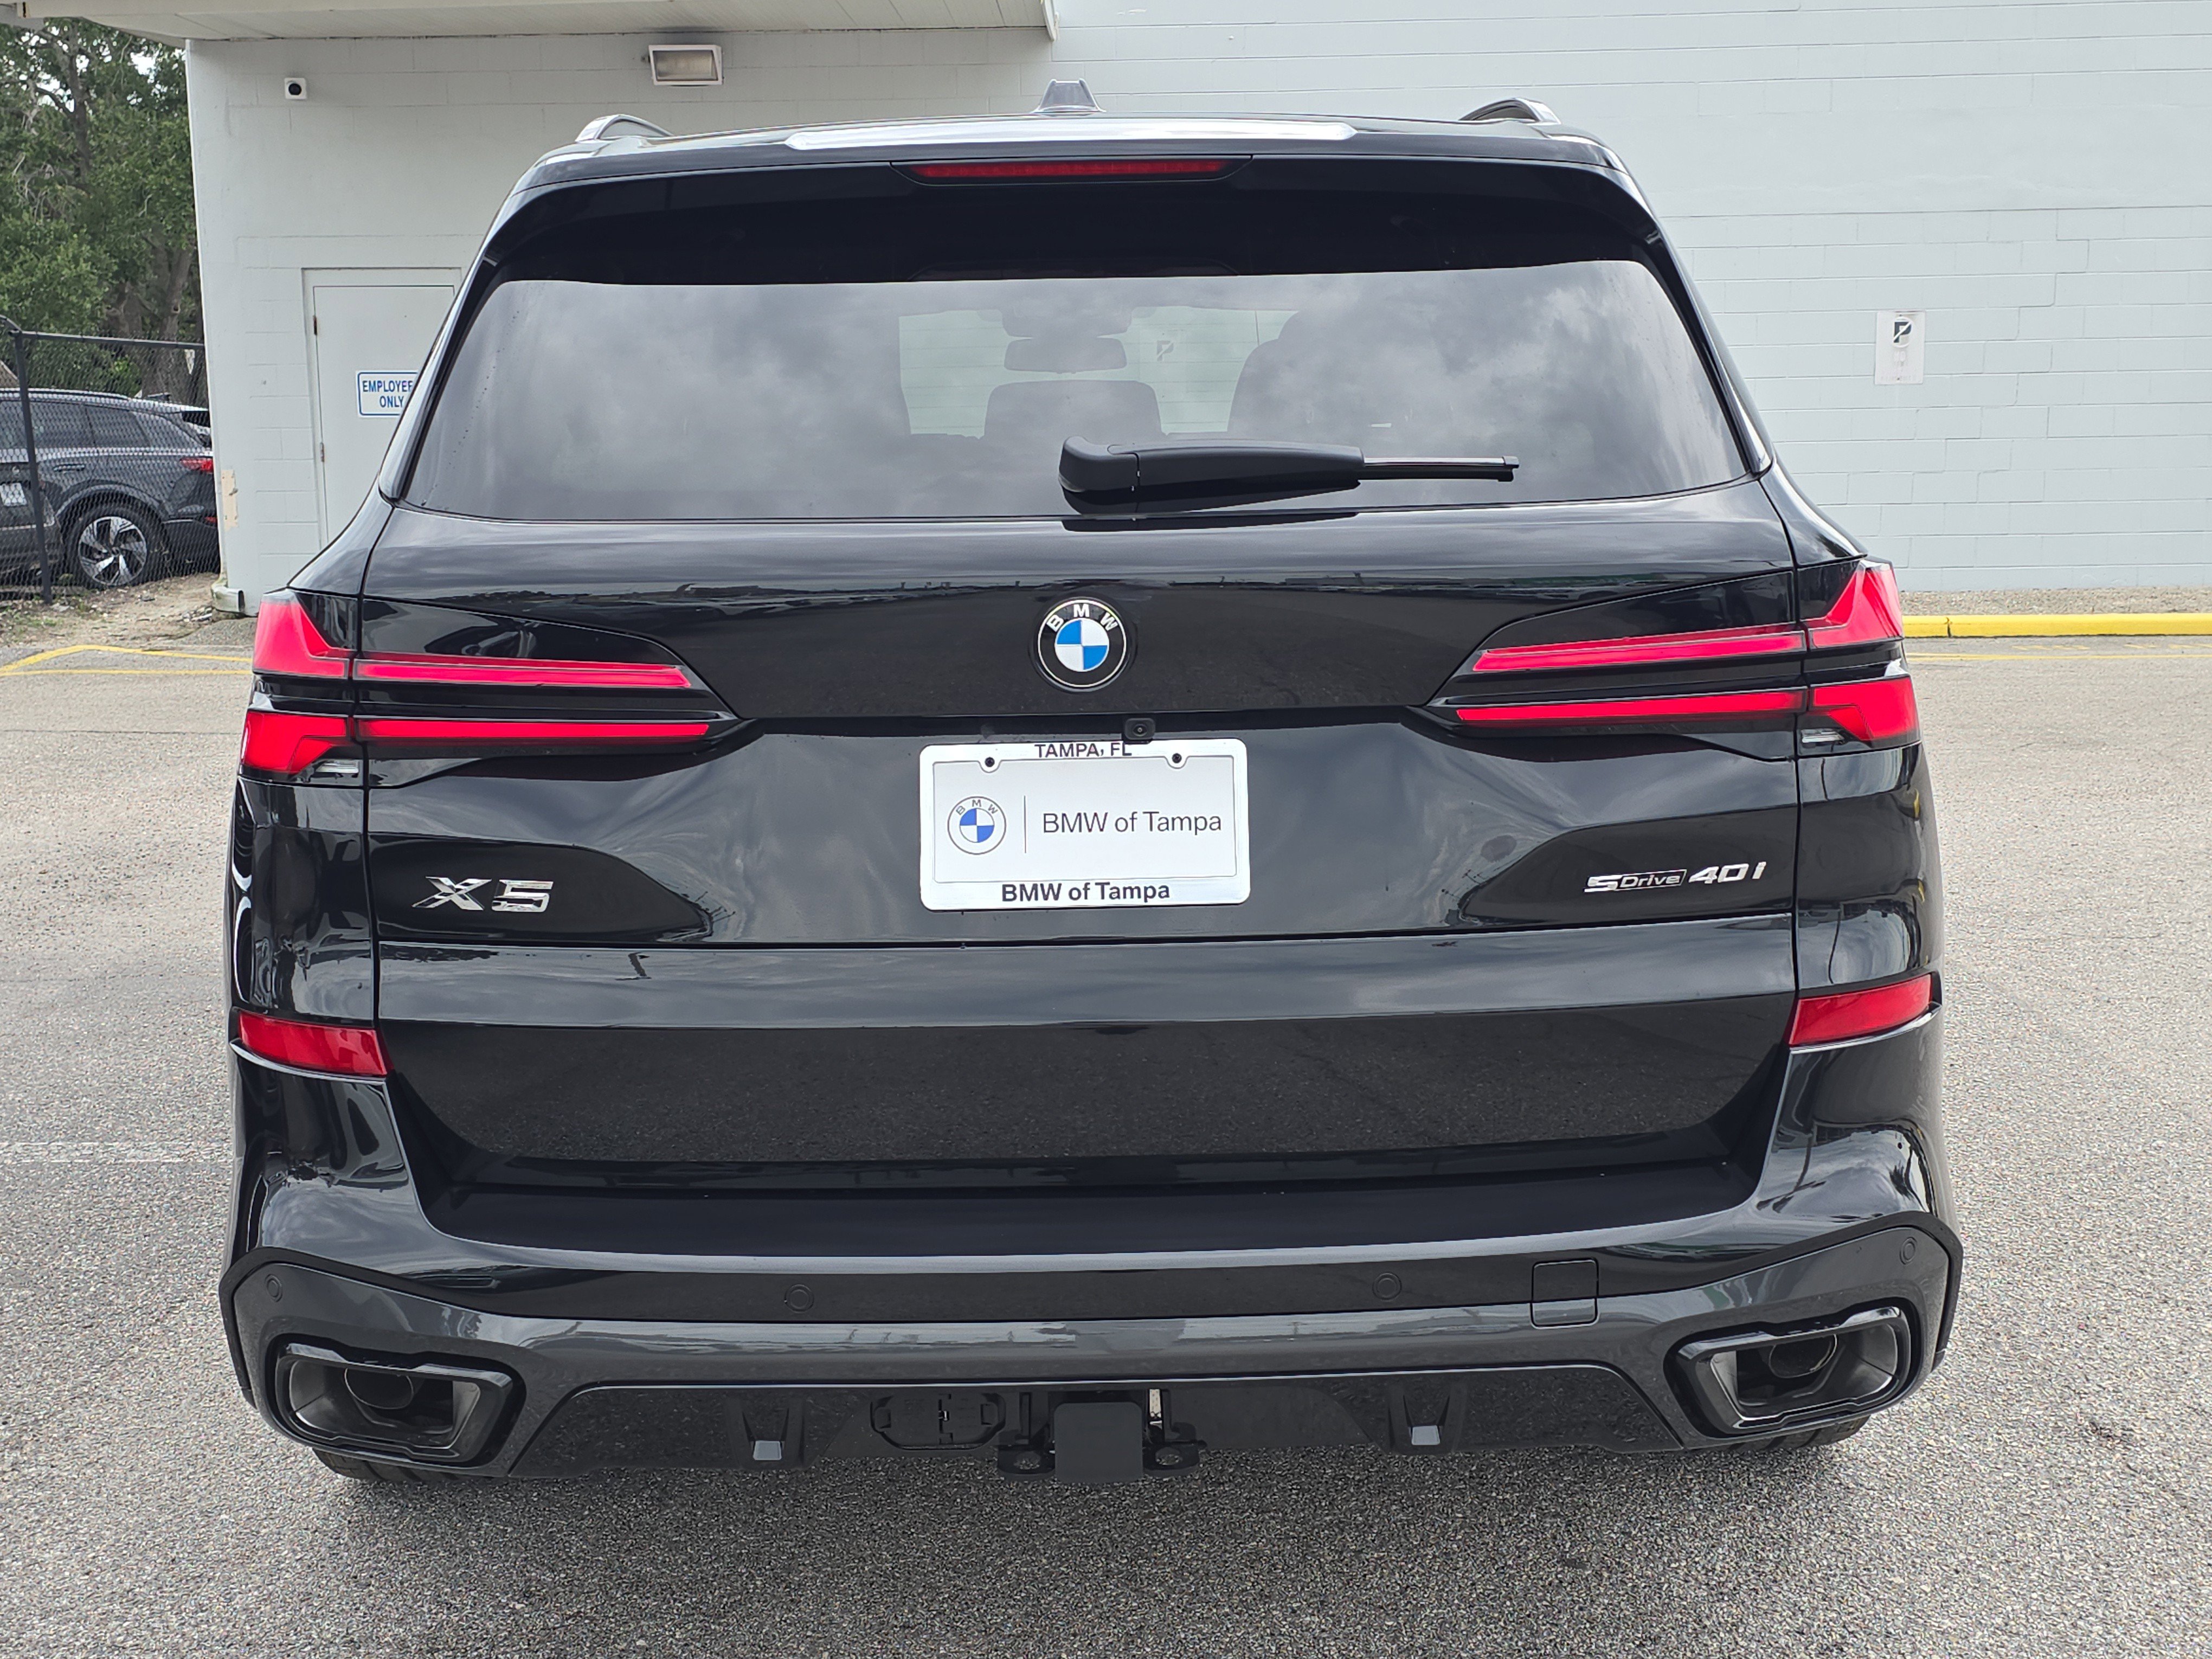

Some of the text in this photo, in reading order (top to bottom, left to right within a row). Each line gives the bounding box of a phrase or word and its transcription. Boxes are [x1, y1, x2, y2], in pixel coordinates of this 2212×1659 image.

[362, 380, 414, 392] EMPLOYEE
[380, 396, 404, 408] ONLY
[1046, 603, 1118, 633] BMW
[1034, 742, 1132, 758] TAMPA, FL
[955, 799, 999, 815] BMW
[1043, 811, 1221, 835] BMW of Tampa
[412, 876, 554, 912] X5
[1002, 881, 1170, 903] BMW of Tampa
